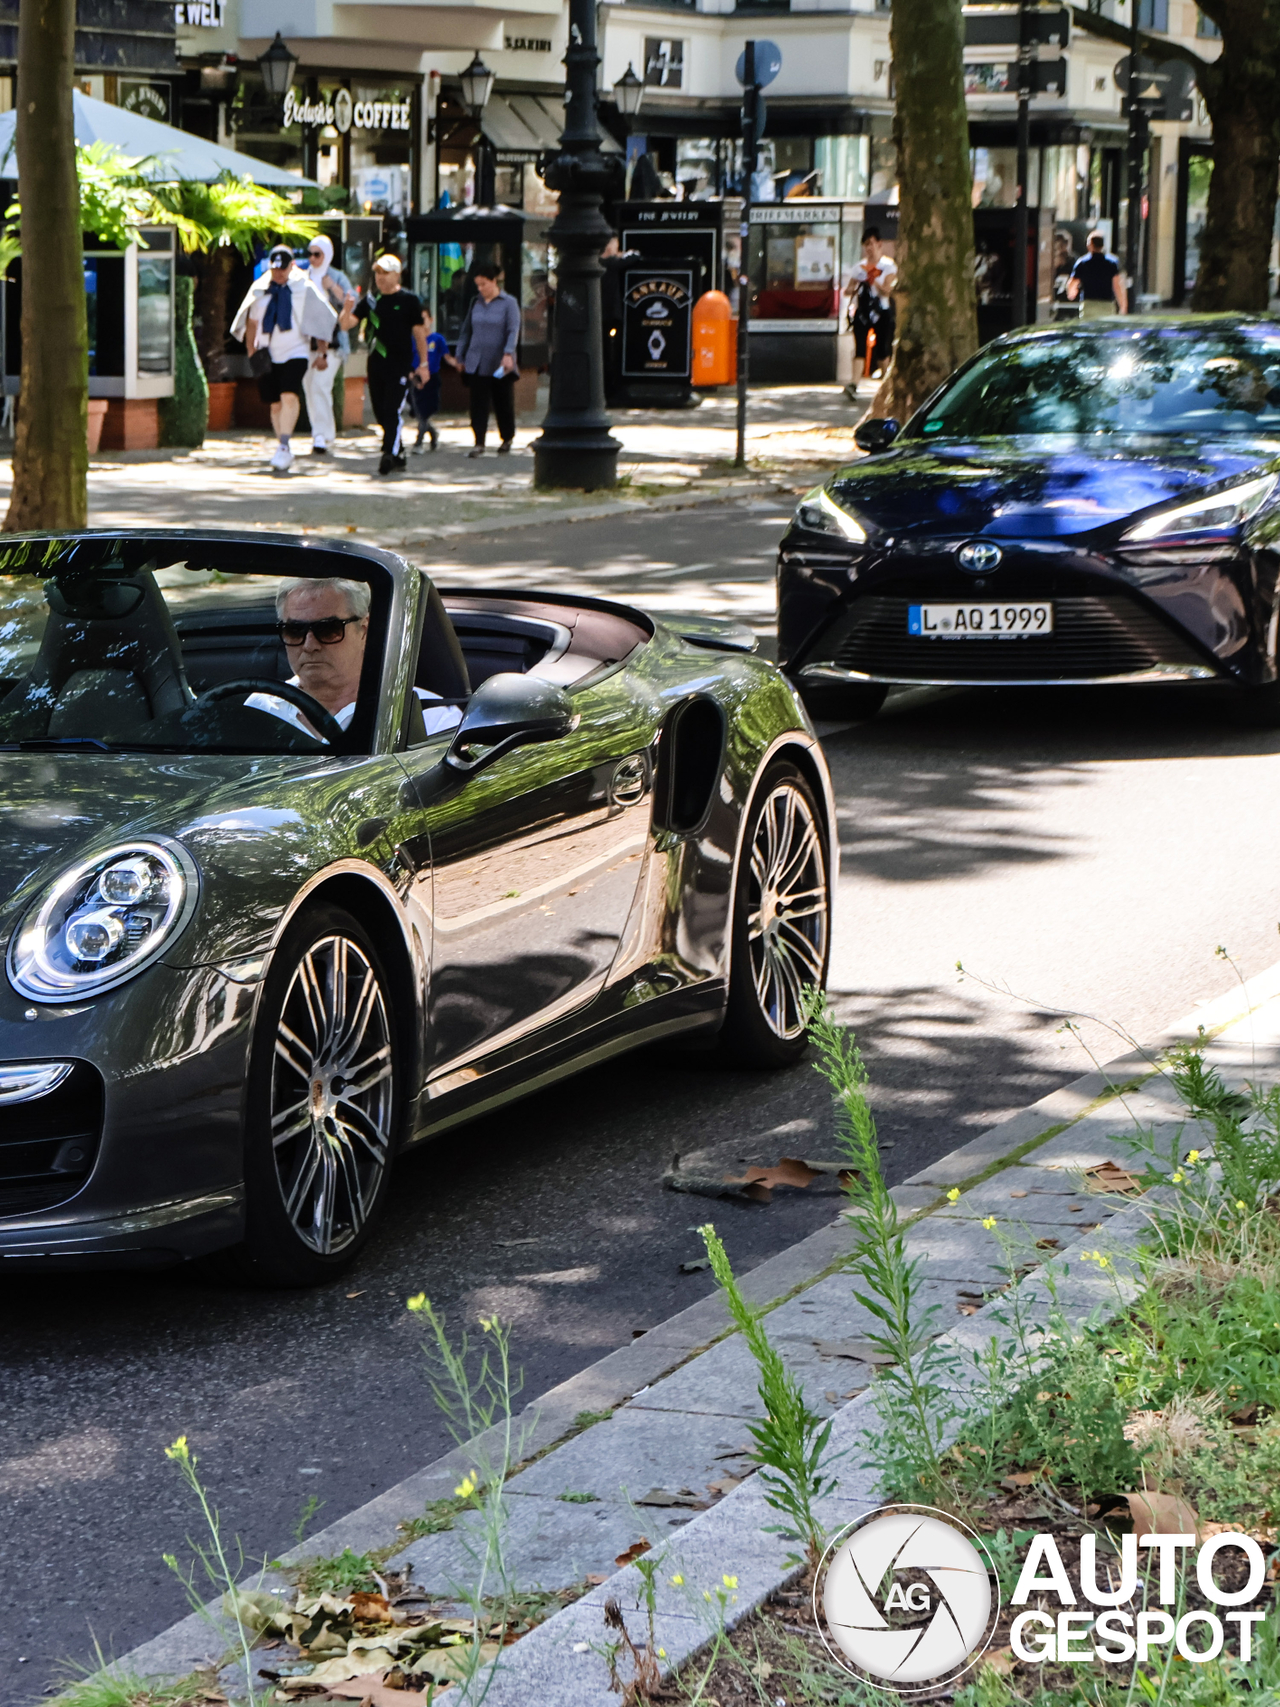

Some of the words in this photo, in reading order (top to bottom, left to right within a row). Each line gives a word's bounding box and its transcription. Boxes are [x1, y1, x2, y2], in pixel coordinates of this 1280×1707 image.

[187, 3, 224, 27] WELT
[284, 88, 334, 128] Exclusive
[354, 100, 410, 130] COFFEE
[632, 281, 684, 301] ANKAUF
[923, 609, 937, 631] L
[954, 609, 984, 631] AQ
[989, 608, 1047, 631] 1999
